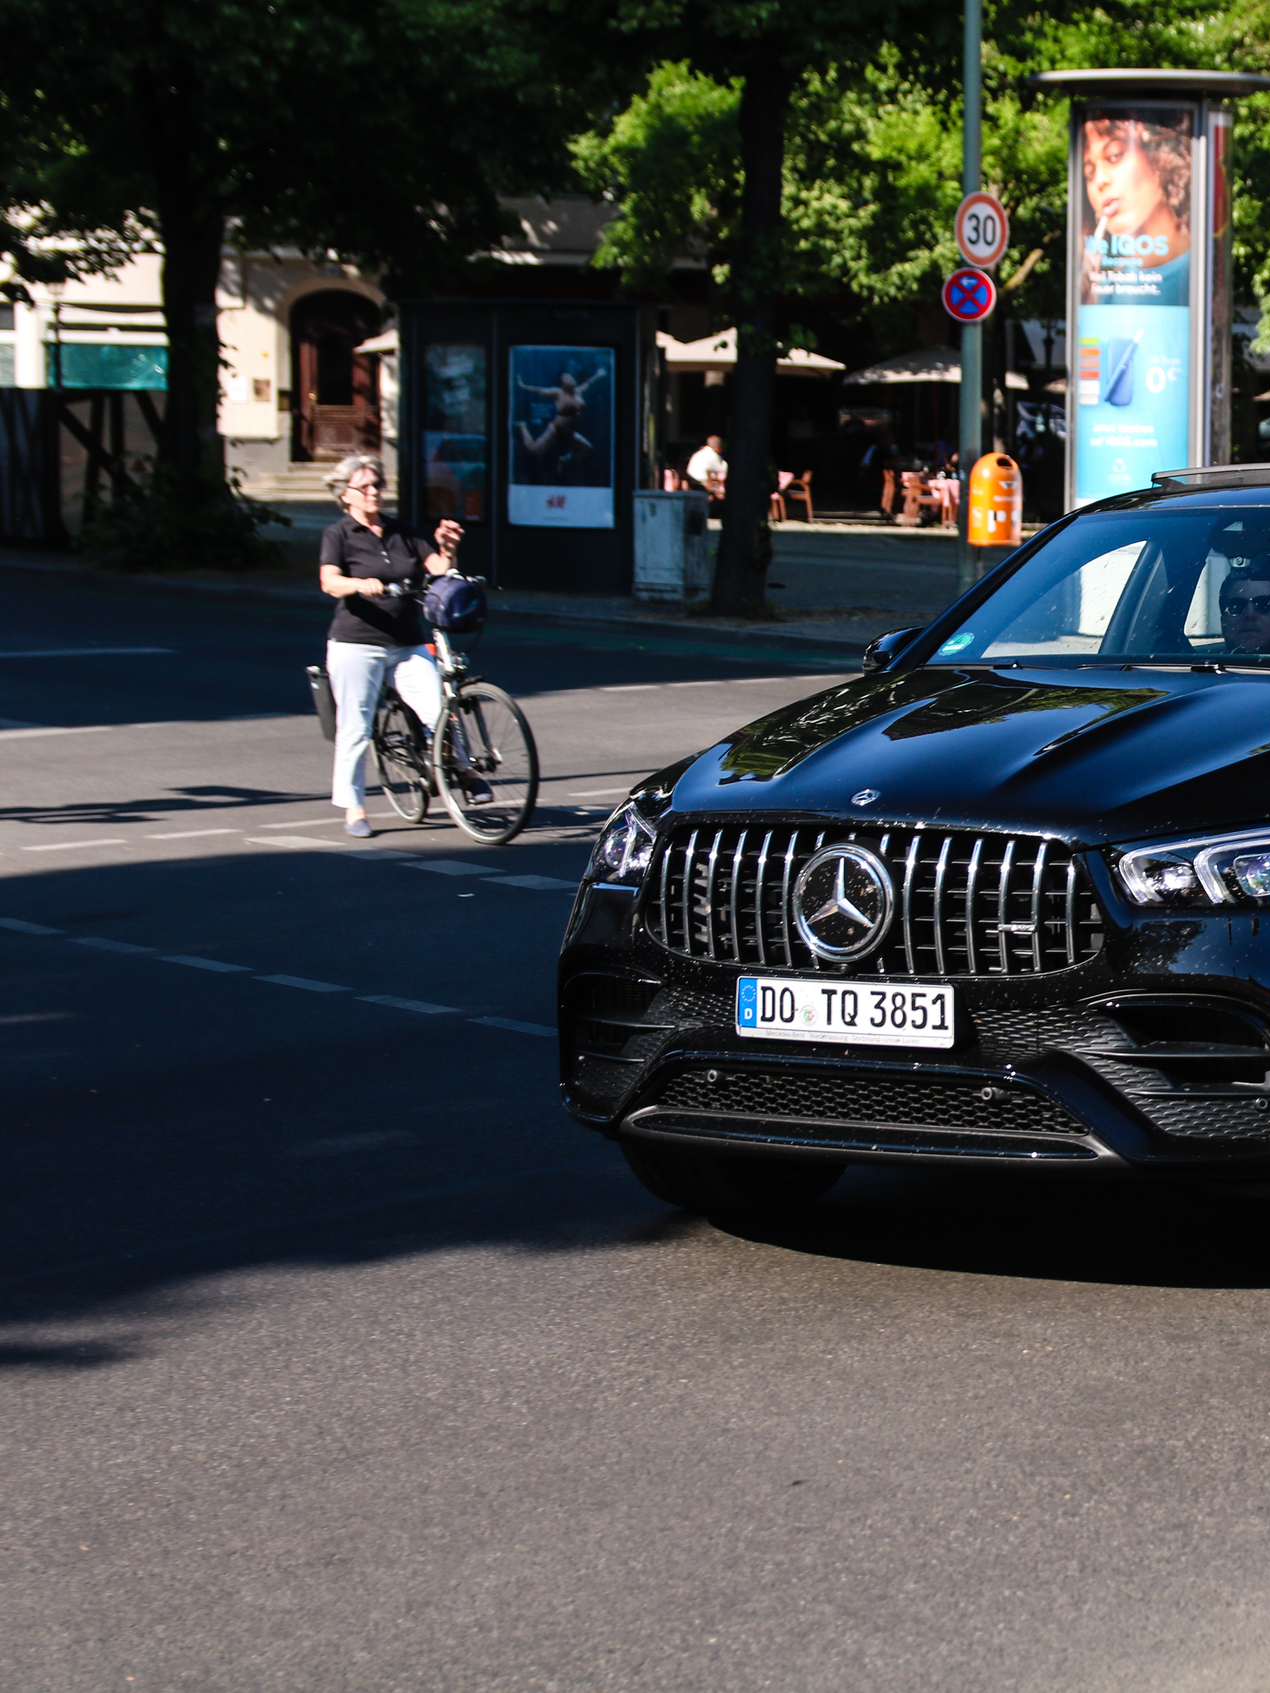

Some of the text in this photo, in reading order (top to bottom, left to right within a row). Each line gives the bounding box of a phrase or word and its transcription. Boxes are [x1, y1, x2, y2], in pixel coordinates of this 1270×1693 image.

[967, 213, 997, 246] 30
[1111, 234, 1169, 256] IQOS
[743, 1007, 753, 1020] D
[760, 986, 949, 1031] DO TQ 3851
